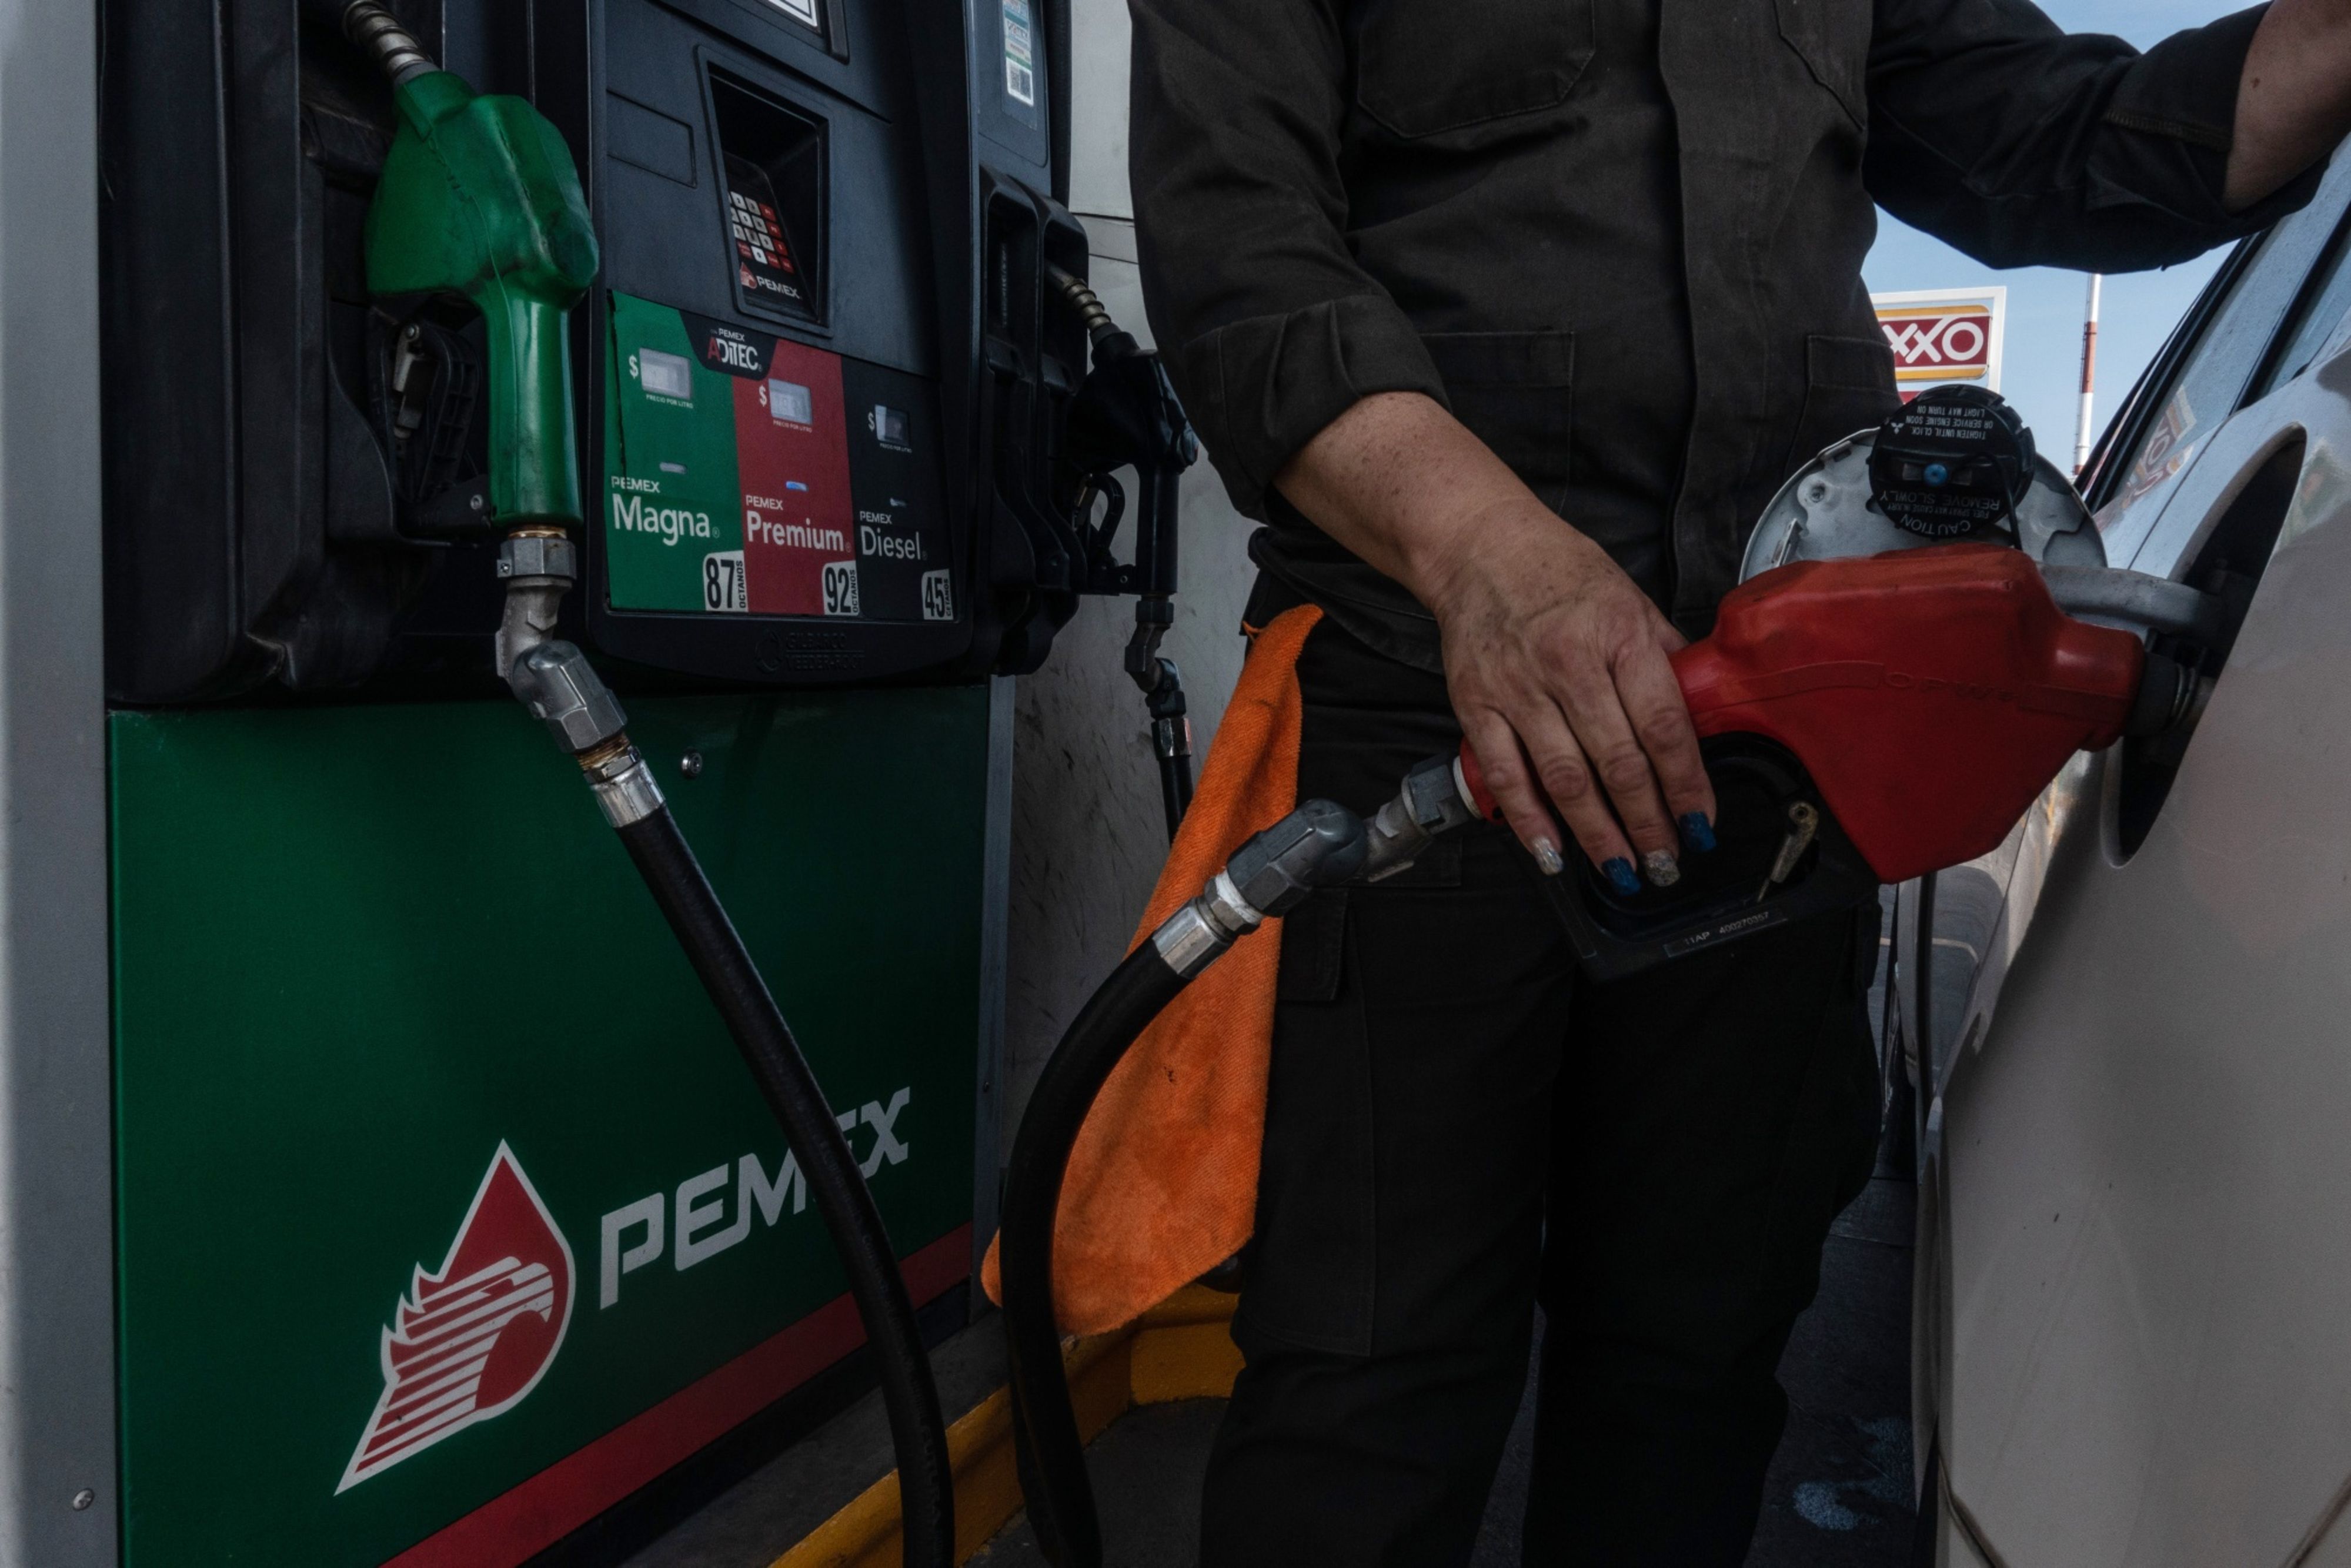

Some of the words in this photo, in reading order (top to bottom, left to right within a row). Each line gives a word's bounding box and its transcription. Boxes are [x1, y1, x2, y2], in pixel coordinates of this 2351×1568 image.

[756, 276, 800, 299] PEMEX
[719, 327, 745, 341] PEMEX
[1882, 316, 1984, 364] XXO
[646, 394, 666, 403] PRECIO
[666, 397, 677, 406] POR
[678, 400, 694, 409] LITRO
[1917, 405, 1926, 414] ON
[1928, 406, 1945, 415] TURN
[1948, 407, 1962, 416] MAY
[1963, 408, 1985, 417] LIGHT
[1905, 415, 1923, 424] SOON
[1925, 416, 1951, 426] ENGINE
[1952, 418, 1982, 429] SERVICE
[1984, 420, 1993, 429] OR
[773, 420, 789, 429] PRECIO
[800, 424, 813, 433] LITRO
[1935, 427, 1955, 437] UNTIL
[1956, 430, 1986, 440] TIGHTEN
[611, 476, 660, 493] PEMEX
[746, 495, 783, 510] PEMEX
[1879, 490, 1936, 504] SLOWLY
[1941, 493, 2001, 510] REMOVE
[1887, 503, 1911, 511] INJURY
[1913, 504, 1933, 513] CAUSE
[1934, 506, 1948, 514] MAY
[1948, 507, 1971, 517] SPRAY
[612, 493, 710, 546] Magna
[860, 511, 892, 524] PEMEX
[1973, 510, 1991, 519] FUEL
[746, 510, 844, 551] Premium
[1900, 513, 1971, 536] CAUTION
[860, 526, 921, 560] Diesel
[706, 558, 734, 609] 87
[736, 560, 746, 609] OCTANOS
[825, 567, 851, 613] 92
[850, 570, 859, 613] OCTANOS
[925, 577, 945, 617] 45
